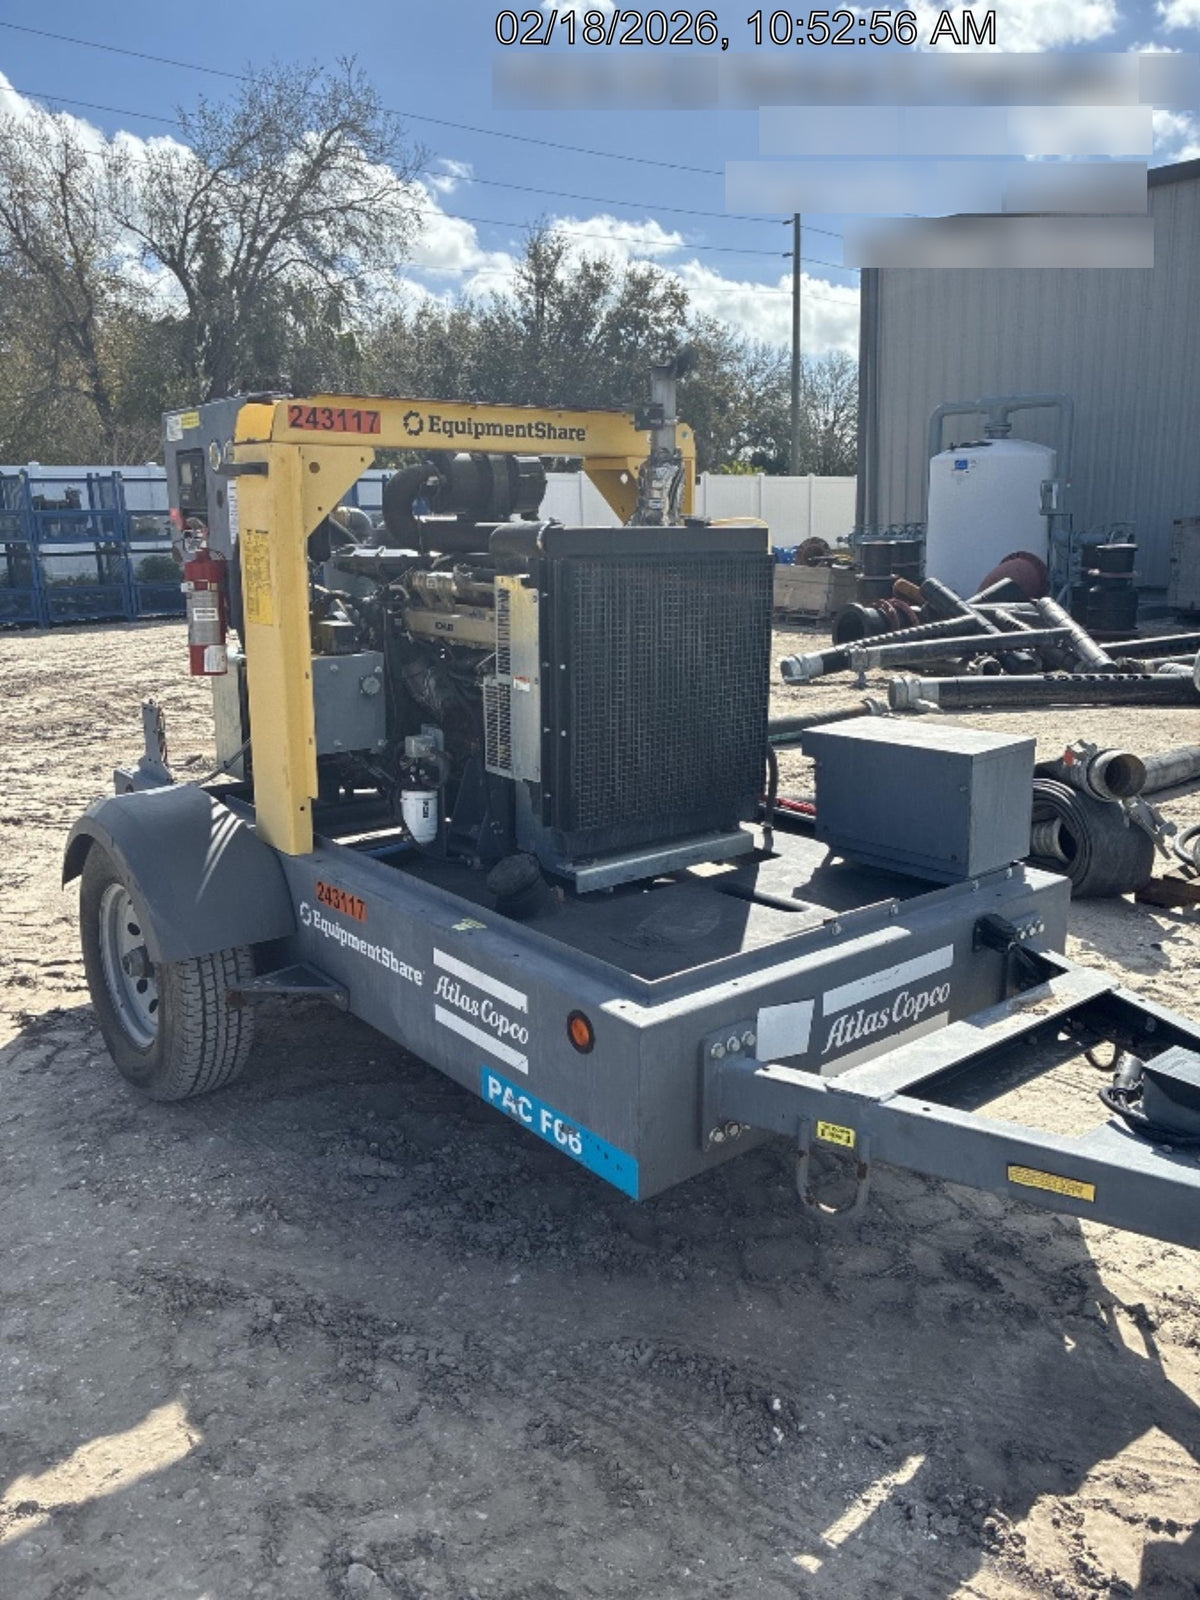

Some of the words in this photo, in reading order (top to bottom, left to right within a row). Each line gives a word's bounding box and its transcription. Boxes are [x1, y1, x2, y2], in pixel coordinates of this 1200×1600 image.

[289, 405, 379, 433] 243117
[428, 415, 586, 441] EquipmentShare
[317, 882, 365, 920] 243117
[312, 910, 424, 986] EquipmentShare
[434, 976, 479, 1017] Atlas
[480, 999, 529, 1045] Copco
[821, 1007, 889, 1055] Atlas
[892, 983, 950, 1023] Copco
[488, 1075, 532, 1123] PAC
